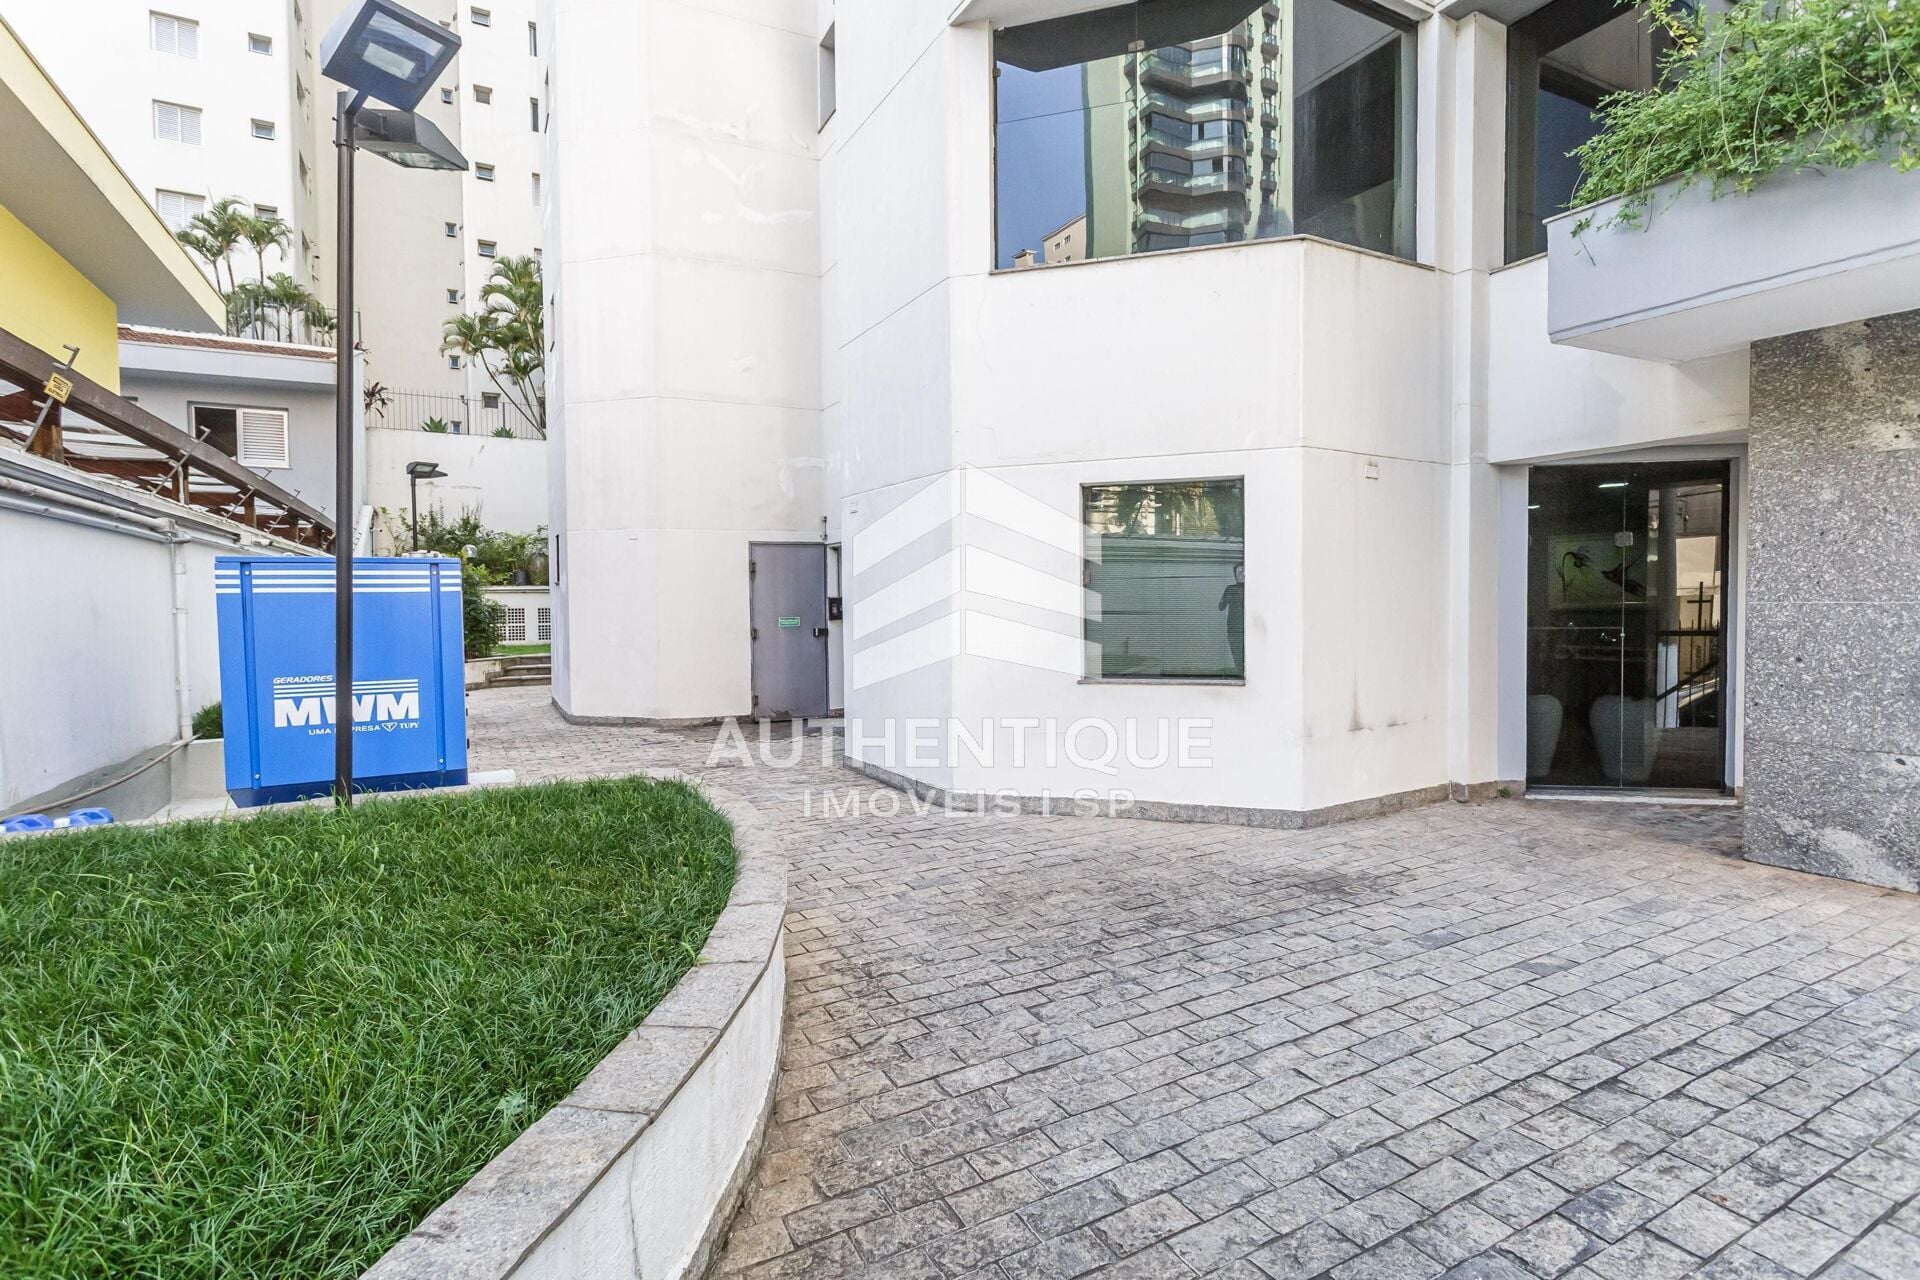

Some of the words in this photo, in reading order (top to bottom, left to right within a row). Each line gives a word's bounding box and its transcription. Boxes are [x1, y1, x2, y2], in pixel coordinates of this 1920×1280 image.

[273, 675, 333, 684] GERADORES
[273, 692, 420, 728] MWM
[308, 728, 332, 736] UMA
[334, 724, 381, 733] RESA
